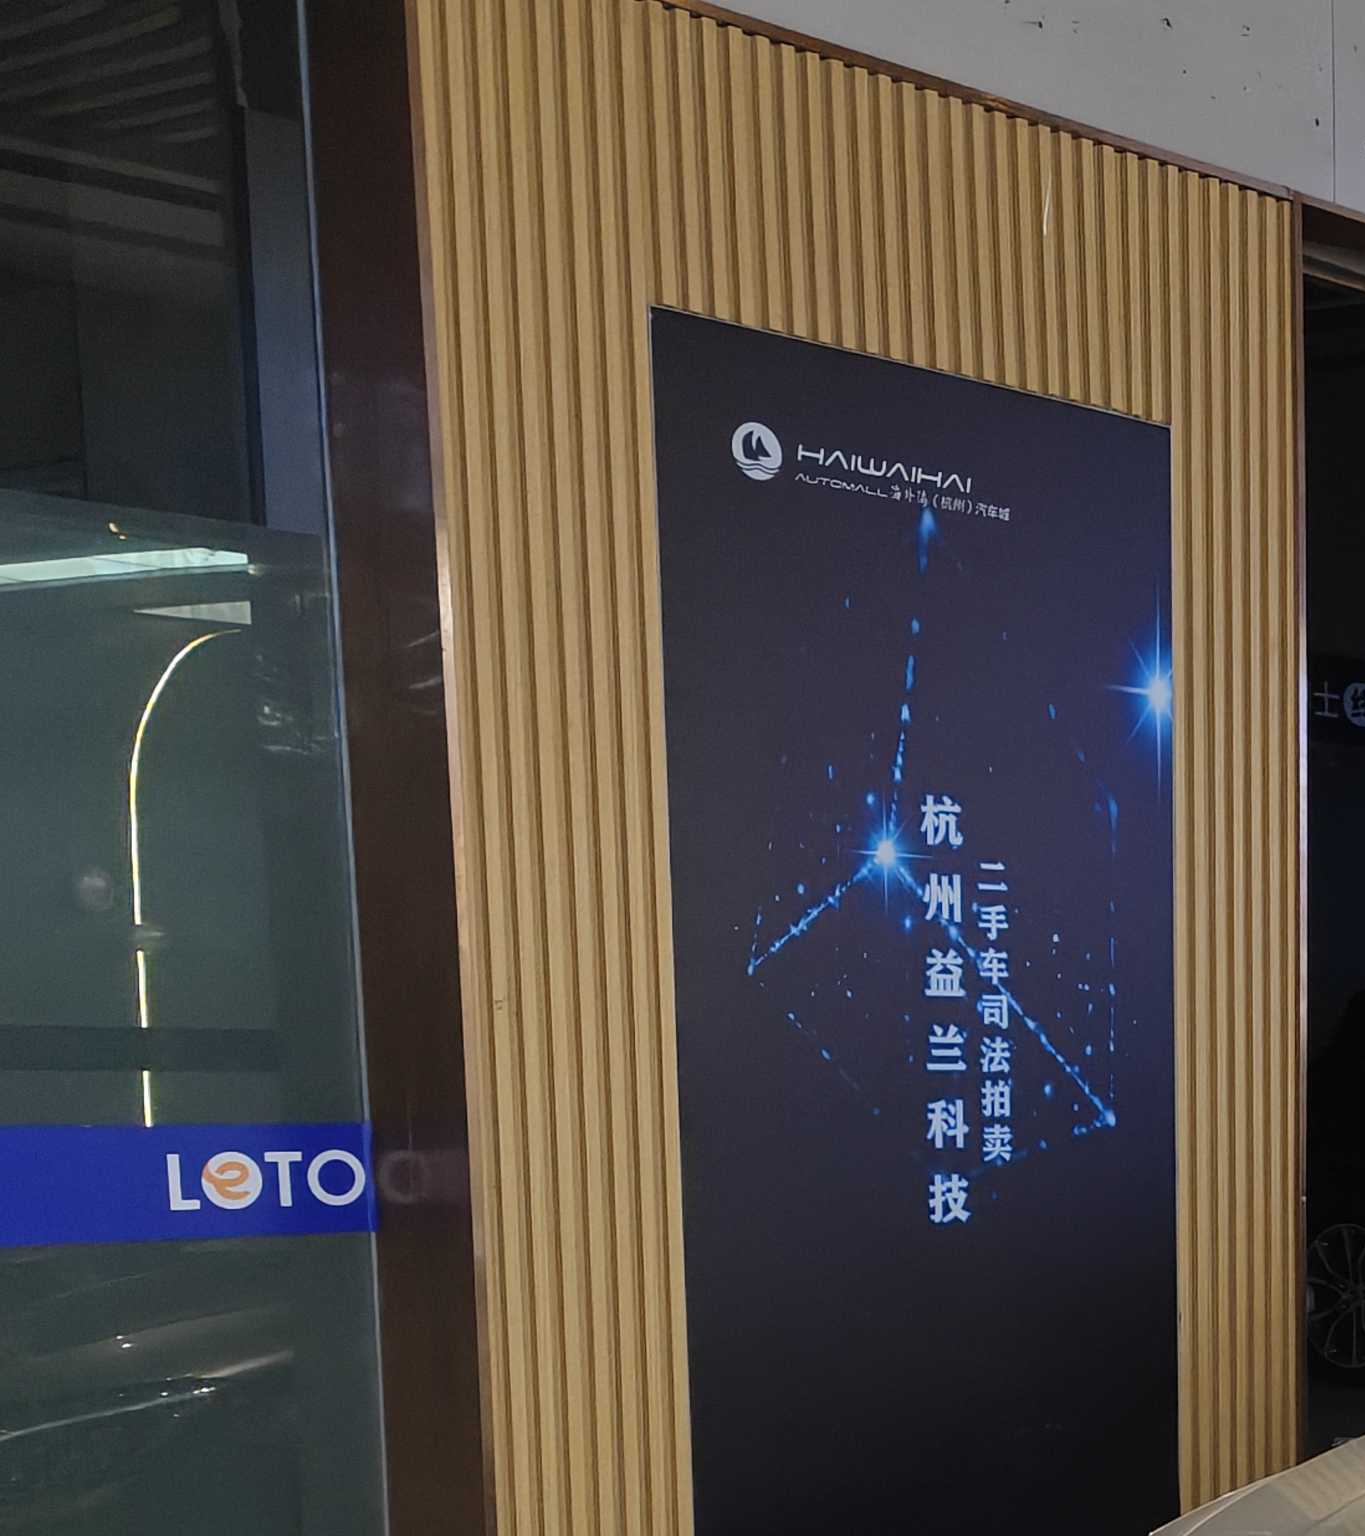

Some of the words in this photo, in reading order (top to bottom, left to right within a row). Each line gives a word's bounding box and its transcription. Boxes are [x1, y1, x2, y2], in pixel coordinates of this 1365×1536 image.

[795, 473, 888, 498] AUTOMALL
[797, 444, 972, 494] HAIWAIHAI
[920, 794, 973, 1224] 杭州益兰科技
[976, 861, 1015, 1162] 二手车司法拍卖
